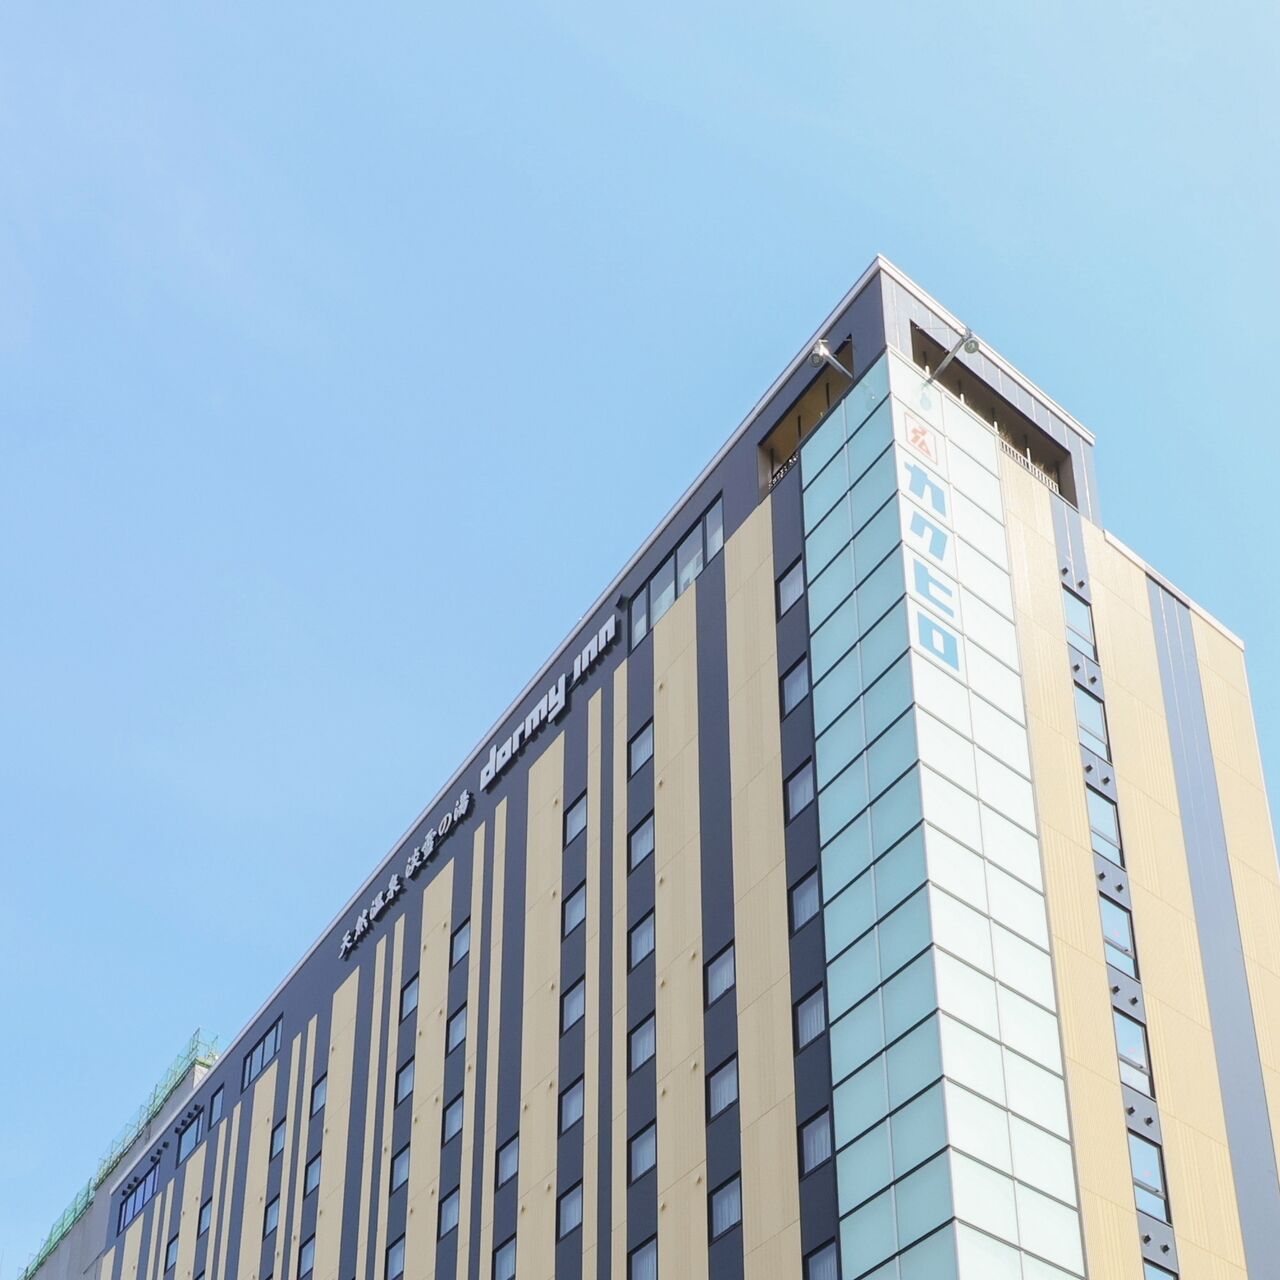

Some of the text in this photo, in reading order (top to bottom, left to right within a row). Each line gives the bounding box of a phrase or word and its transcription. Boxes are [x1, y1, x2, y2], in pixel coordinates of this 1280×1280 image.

[904, 462, 960, 671] カクヒロ
[480, 614, 616, 791] dormy inn
